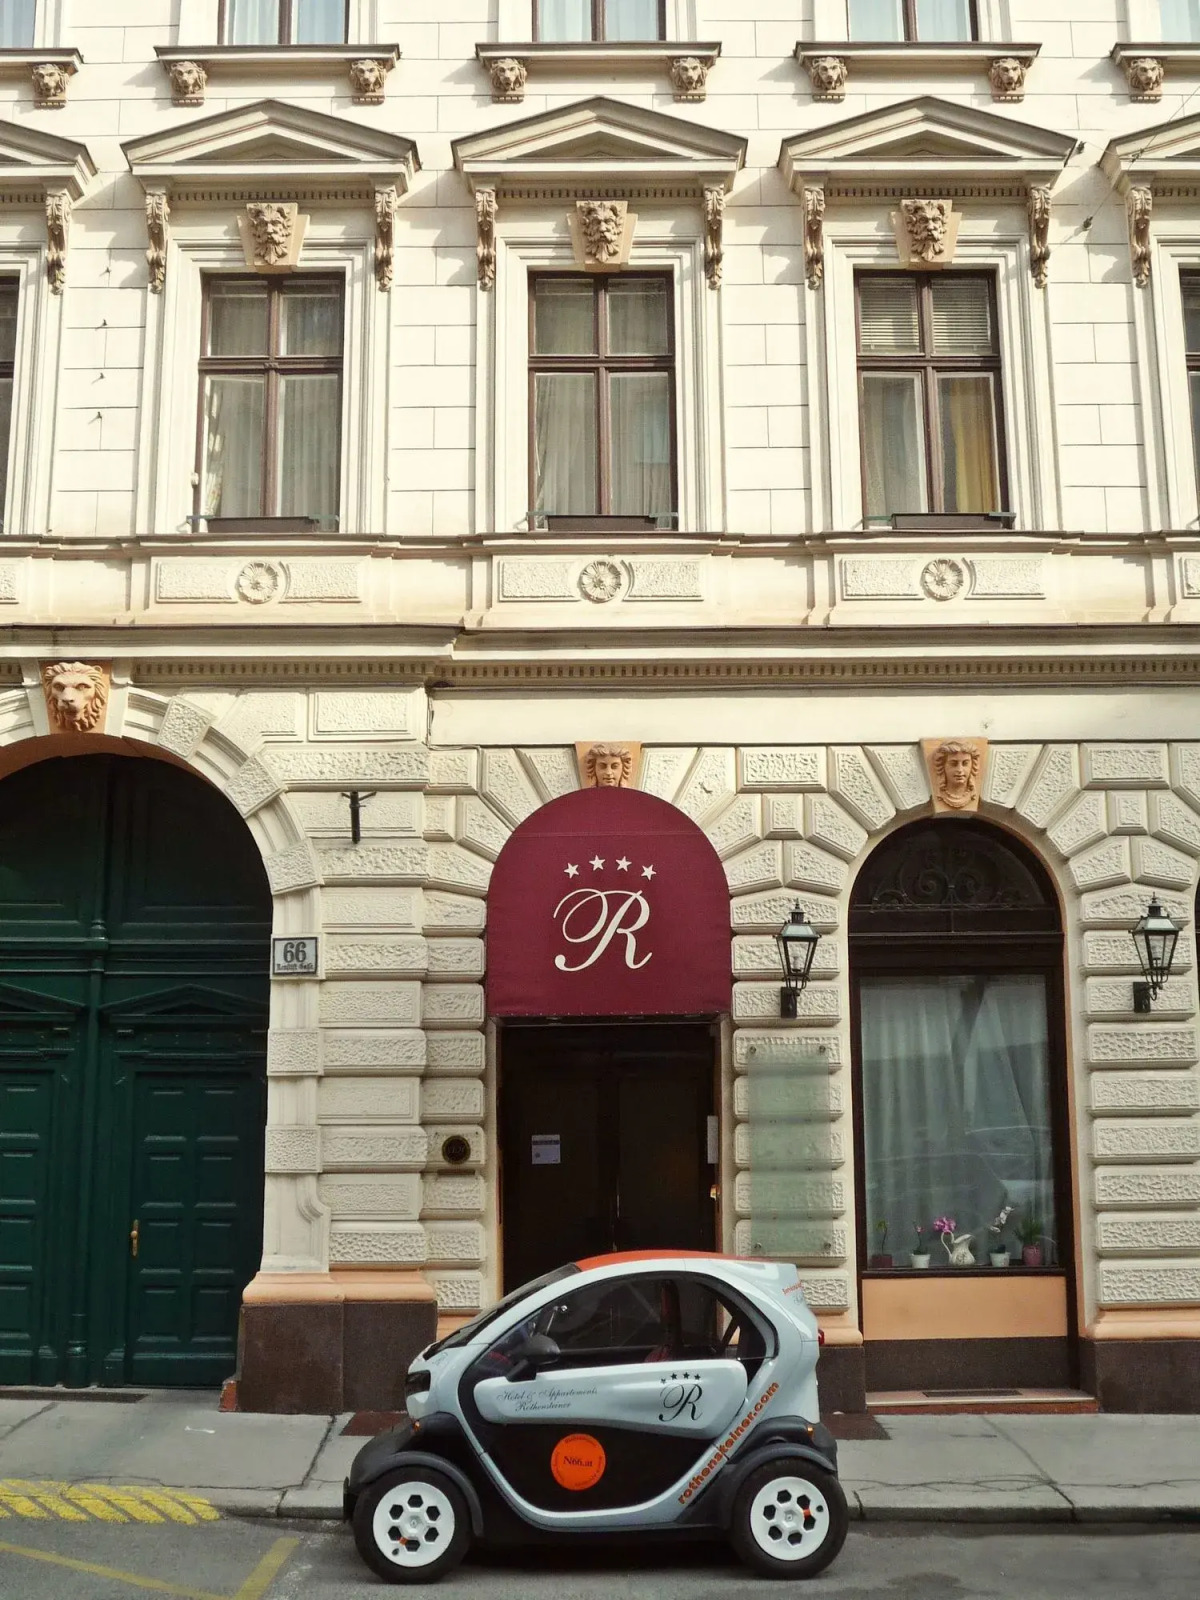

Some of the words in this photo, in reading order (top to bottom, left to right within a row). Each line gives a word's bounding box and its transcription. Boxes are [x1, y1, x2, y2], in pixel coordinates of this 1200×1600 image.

[553, 888, 653, 972] R
[283, 941, 307, 963] 66
[496, 1390, 526, 1402] Hotel
[658, 1384, 703, 1422] R
[678, 1382, 779, 1504] rothensteiner.com
